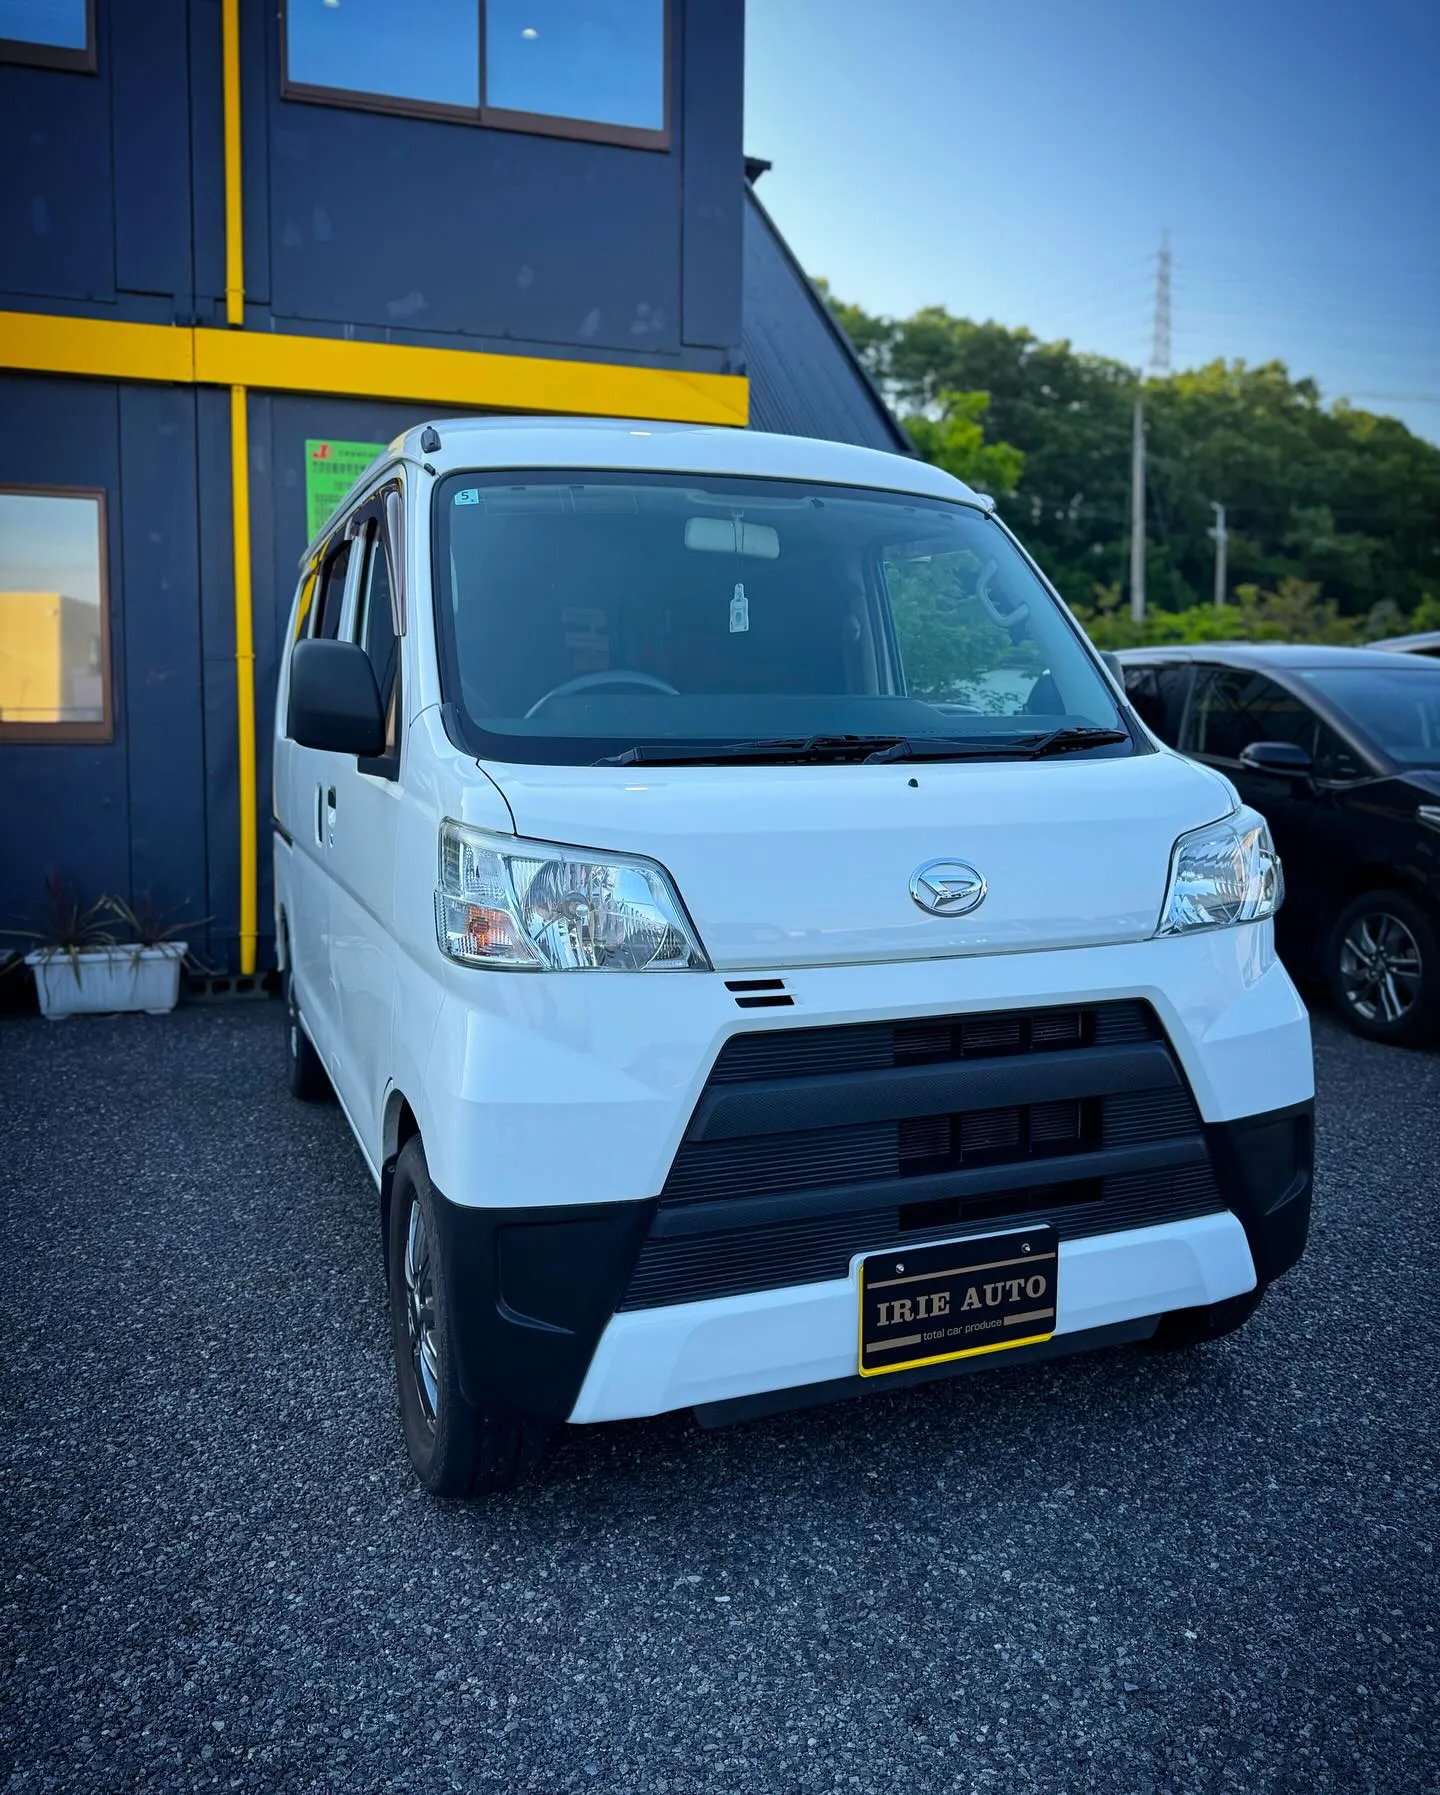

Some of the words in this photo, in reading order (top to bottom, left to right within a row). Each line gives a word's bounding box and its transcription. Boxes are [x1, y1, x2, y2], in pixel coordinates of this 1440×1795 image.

[877, 1291, 950, 1326] IRIE
[960, 1275, 1047, 1311] AUTO
[923, 1327, 945, 1341] total
[947, 1325, 963, 1336] car
[964, 1319, 1002, 1334] produce
